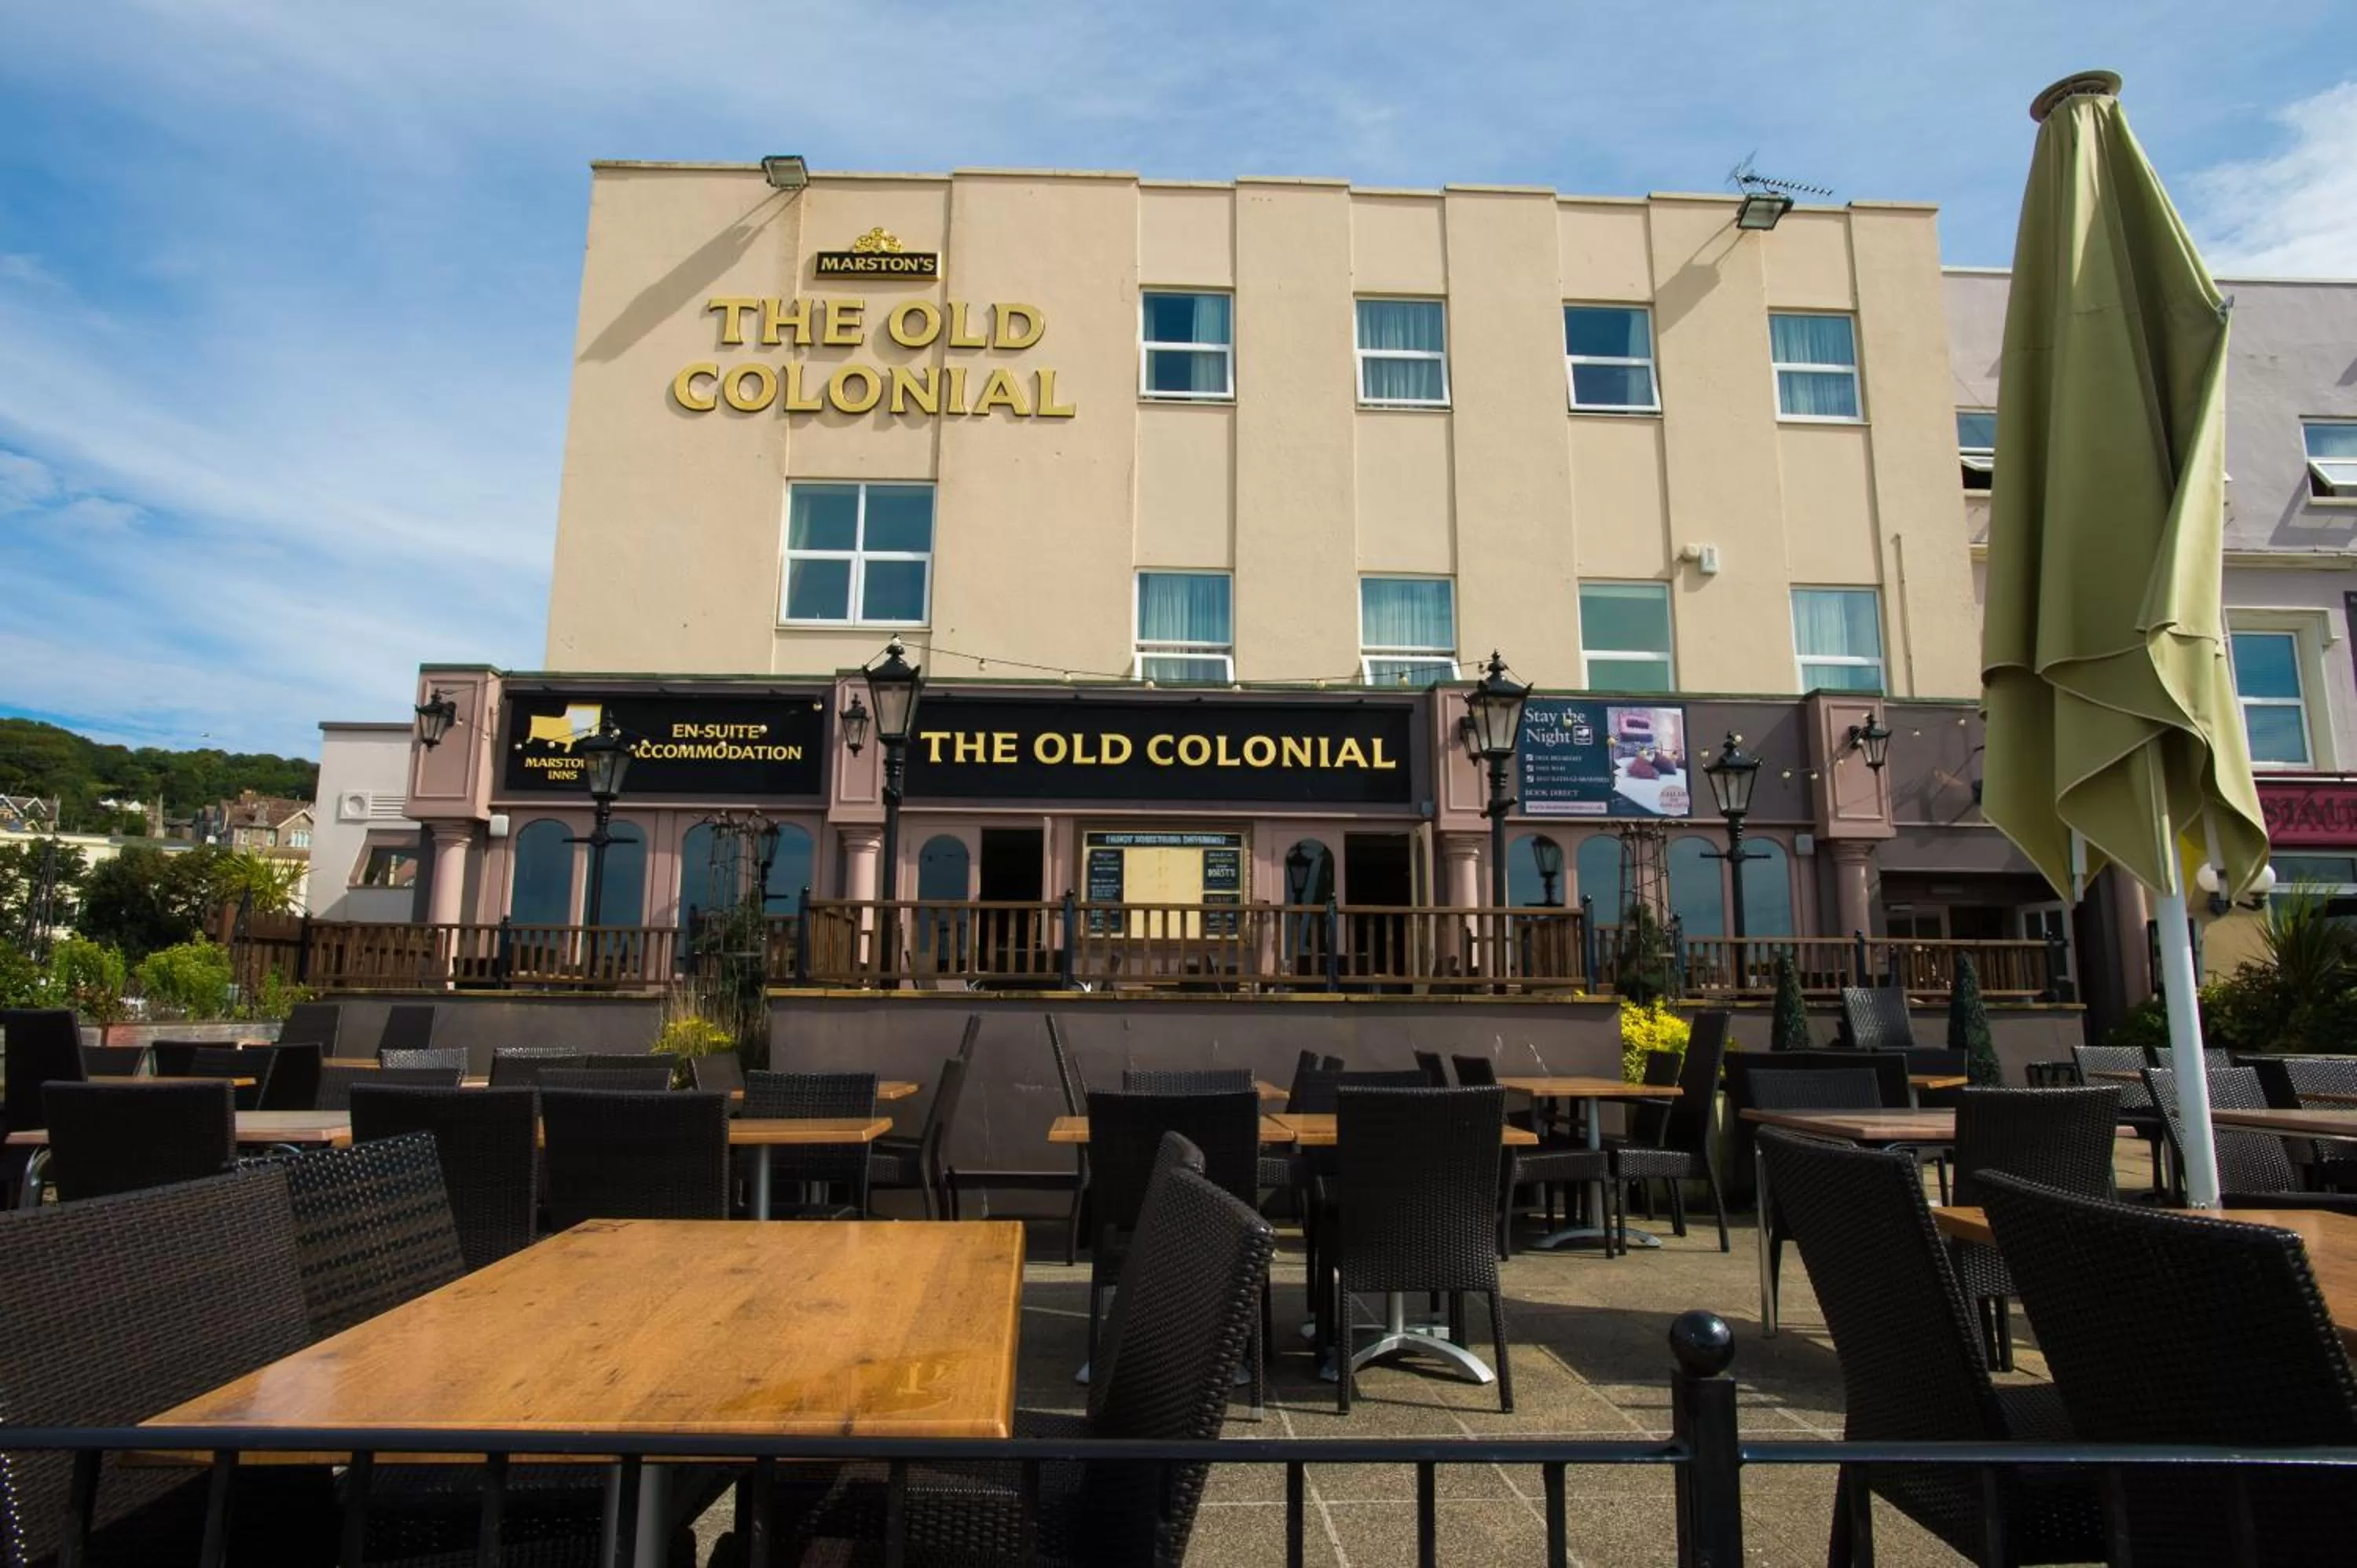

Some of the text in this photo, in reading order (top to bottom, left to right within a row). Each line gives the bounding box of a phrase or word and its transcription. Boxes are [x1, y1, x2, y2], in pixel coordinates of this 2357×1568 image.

[820, 255, 935, 273] MARSTON'S
[709, 297, 1046, 350] THE OLD
[673, 362, 1077, 417] COLONIAL
[1525, 707, 1585, 727] Stay the
[672, 723, 761, 739] EN-SUITE
[1526, 727, 1571, 747] Night
[920, 731, 1397, 770] THE OLD COLONIAL
[525, 757, 585, 769] MARSTO
[548, 770, 579, 780] INNS
